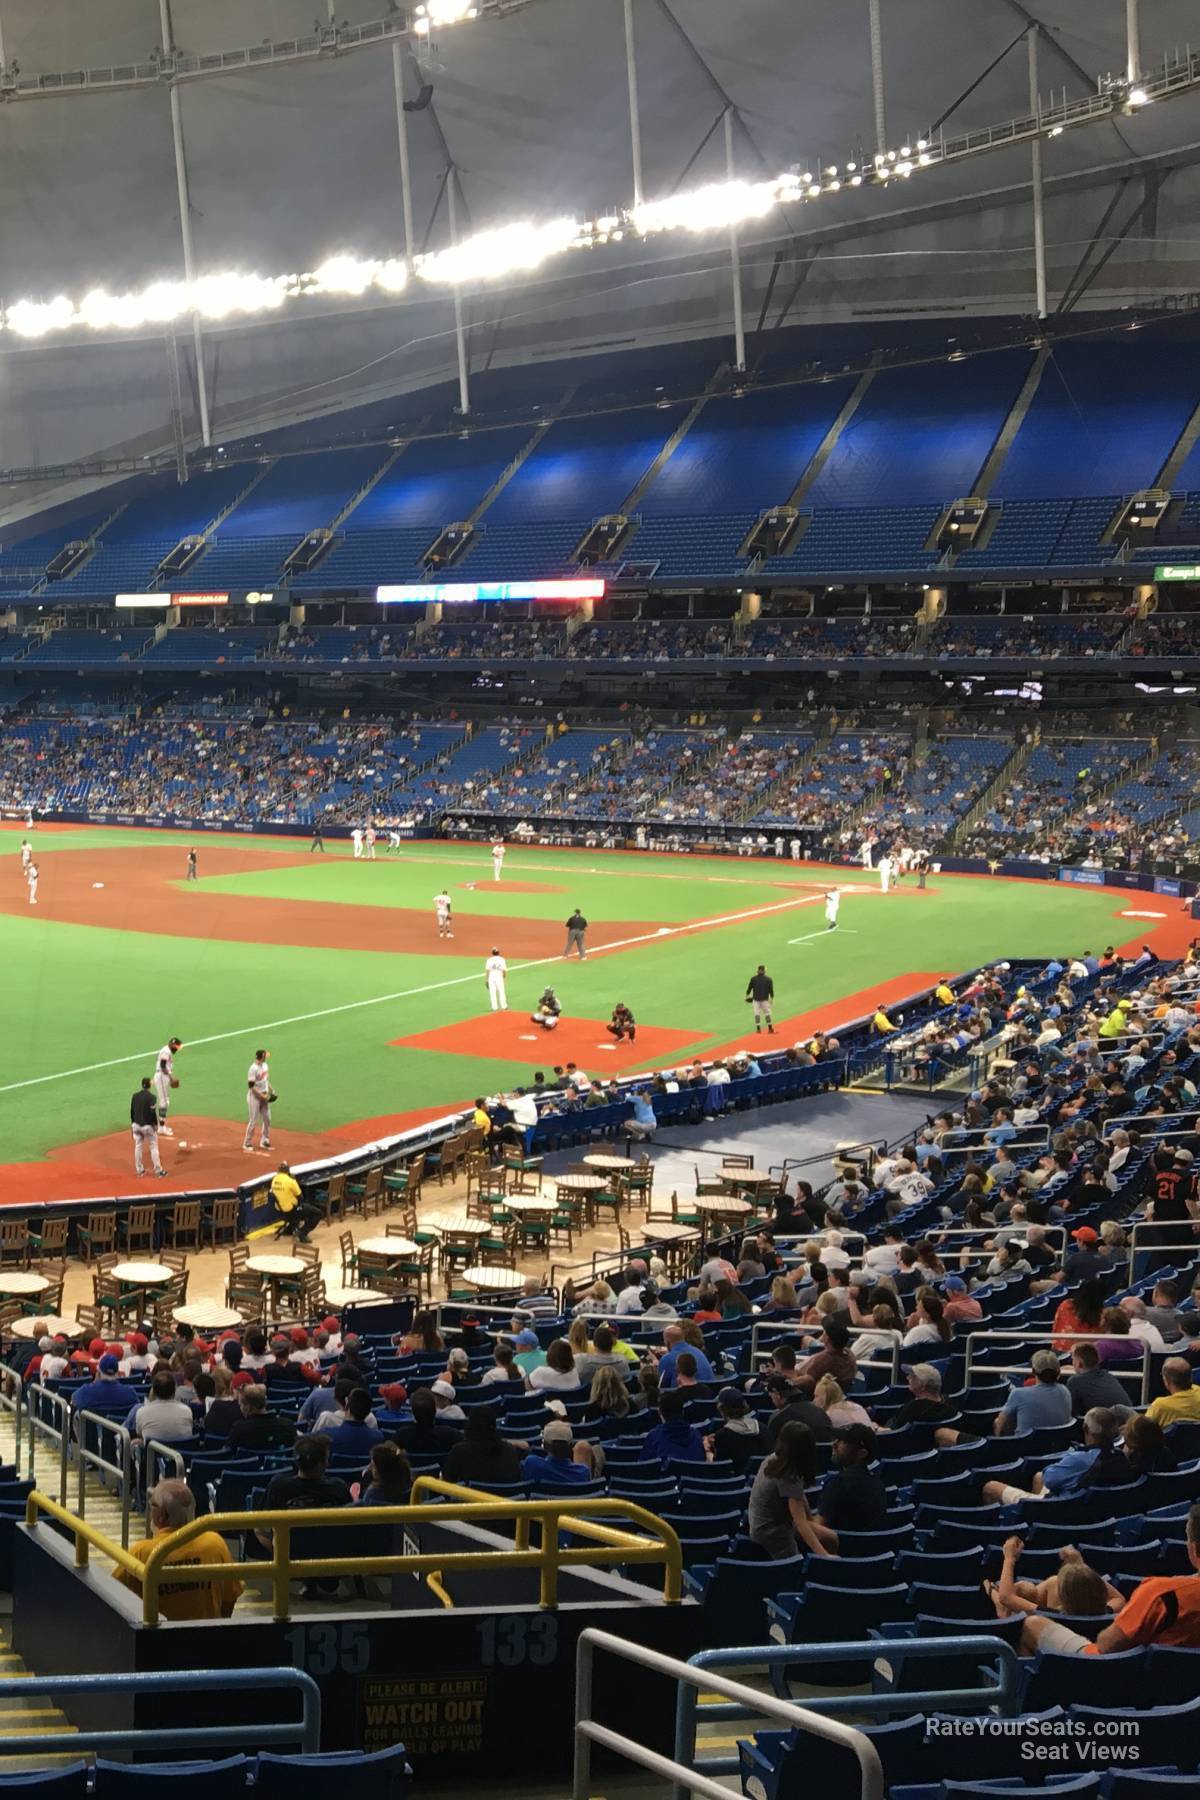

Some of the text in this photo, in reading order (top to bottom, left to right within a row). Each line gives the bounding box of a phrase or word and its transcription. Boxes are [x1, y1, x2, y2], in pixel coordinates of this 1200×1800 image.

[908, 1181, 926, 1197] 39
[1158, 1181, 1175, 1200] 21
[285, 1622, 371, 1675] 135
[476, 1614, 558, 1665] 133
[369, 1682, 416, 1697] PLEASE
[420, 1681, 436, 1696] BE
[365, 1700, 485, 1726] WATCH OUT
[364, 1724, 482, 1742] FOR BALLS LEAVING
[451, 1738, 482, 1753] PLAY
